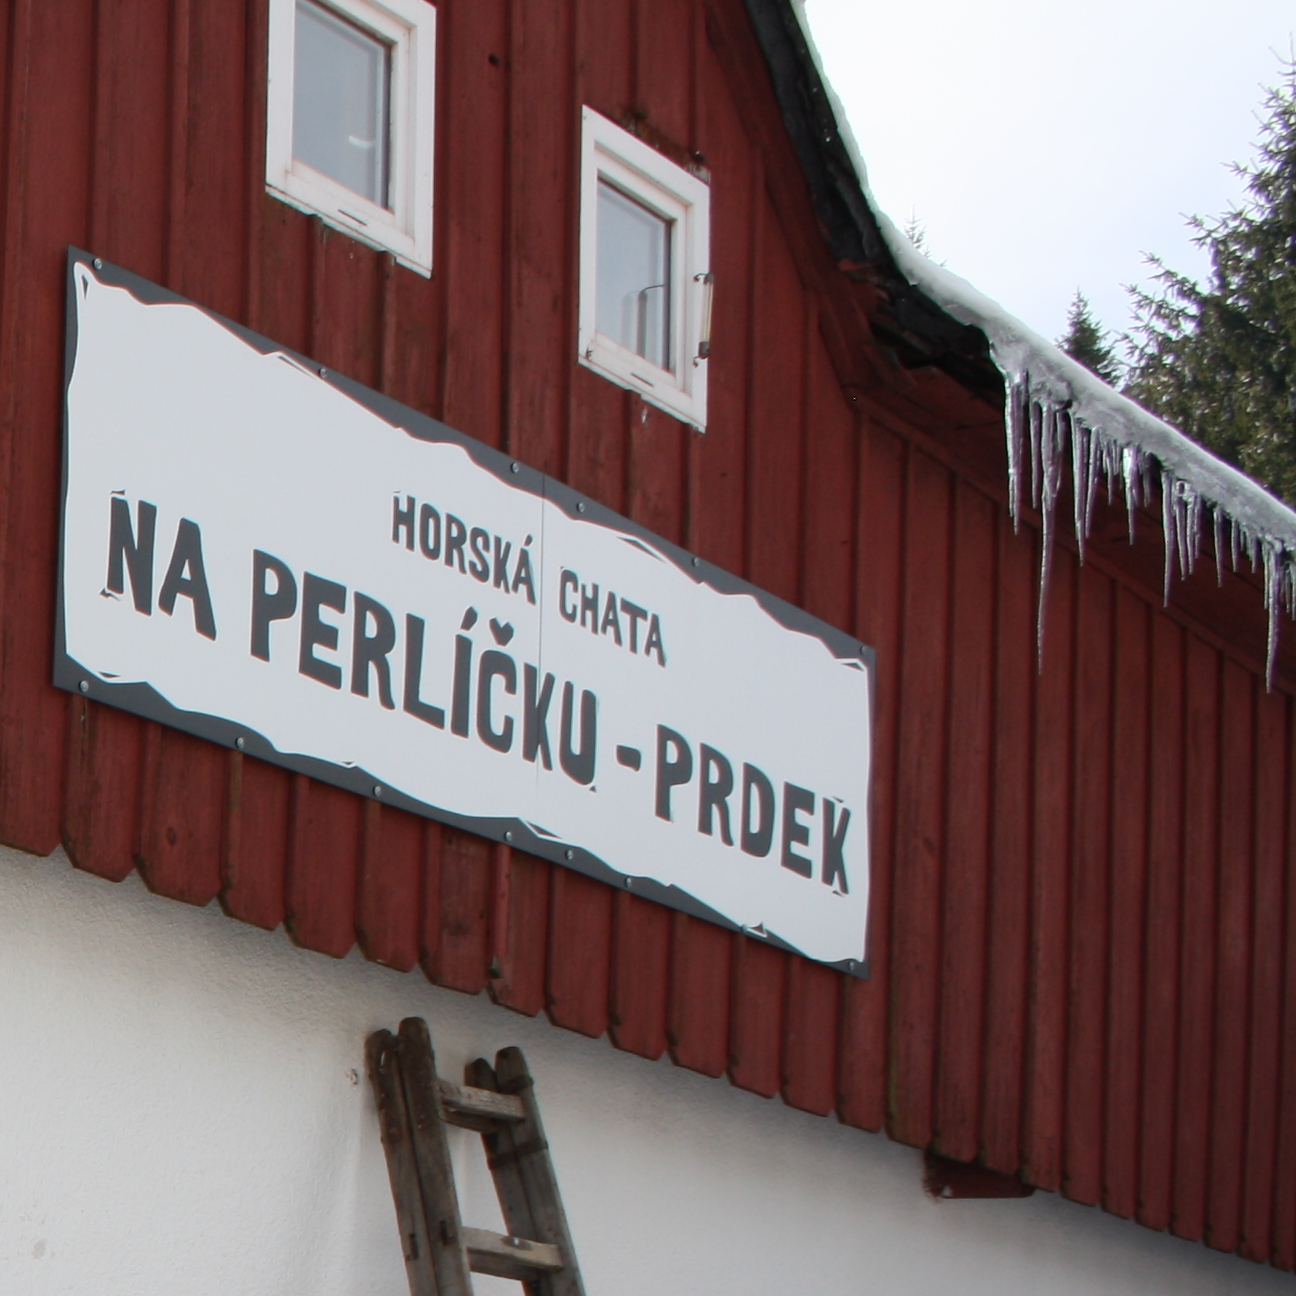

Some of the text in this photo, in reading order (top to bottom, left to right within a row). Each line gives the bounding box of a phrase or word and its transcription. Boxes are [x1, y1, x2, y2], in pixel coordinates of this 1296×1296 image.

[102, 493, 217, 642] NA
[249, 547, 599, 788] PERLÍČKU
[654, 722, 851, 896] PRDEK
[391, 493, 667, 668] HORSKÁ CHATA
